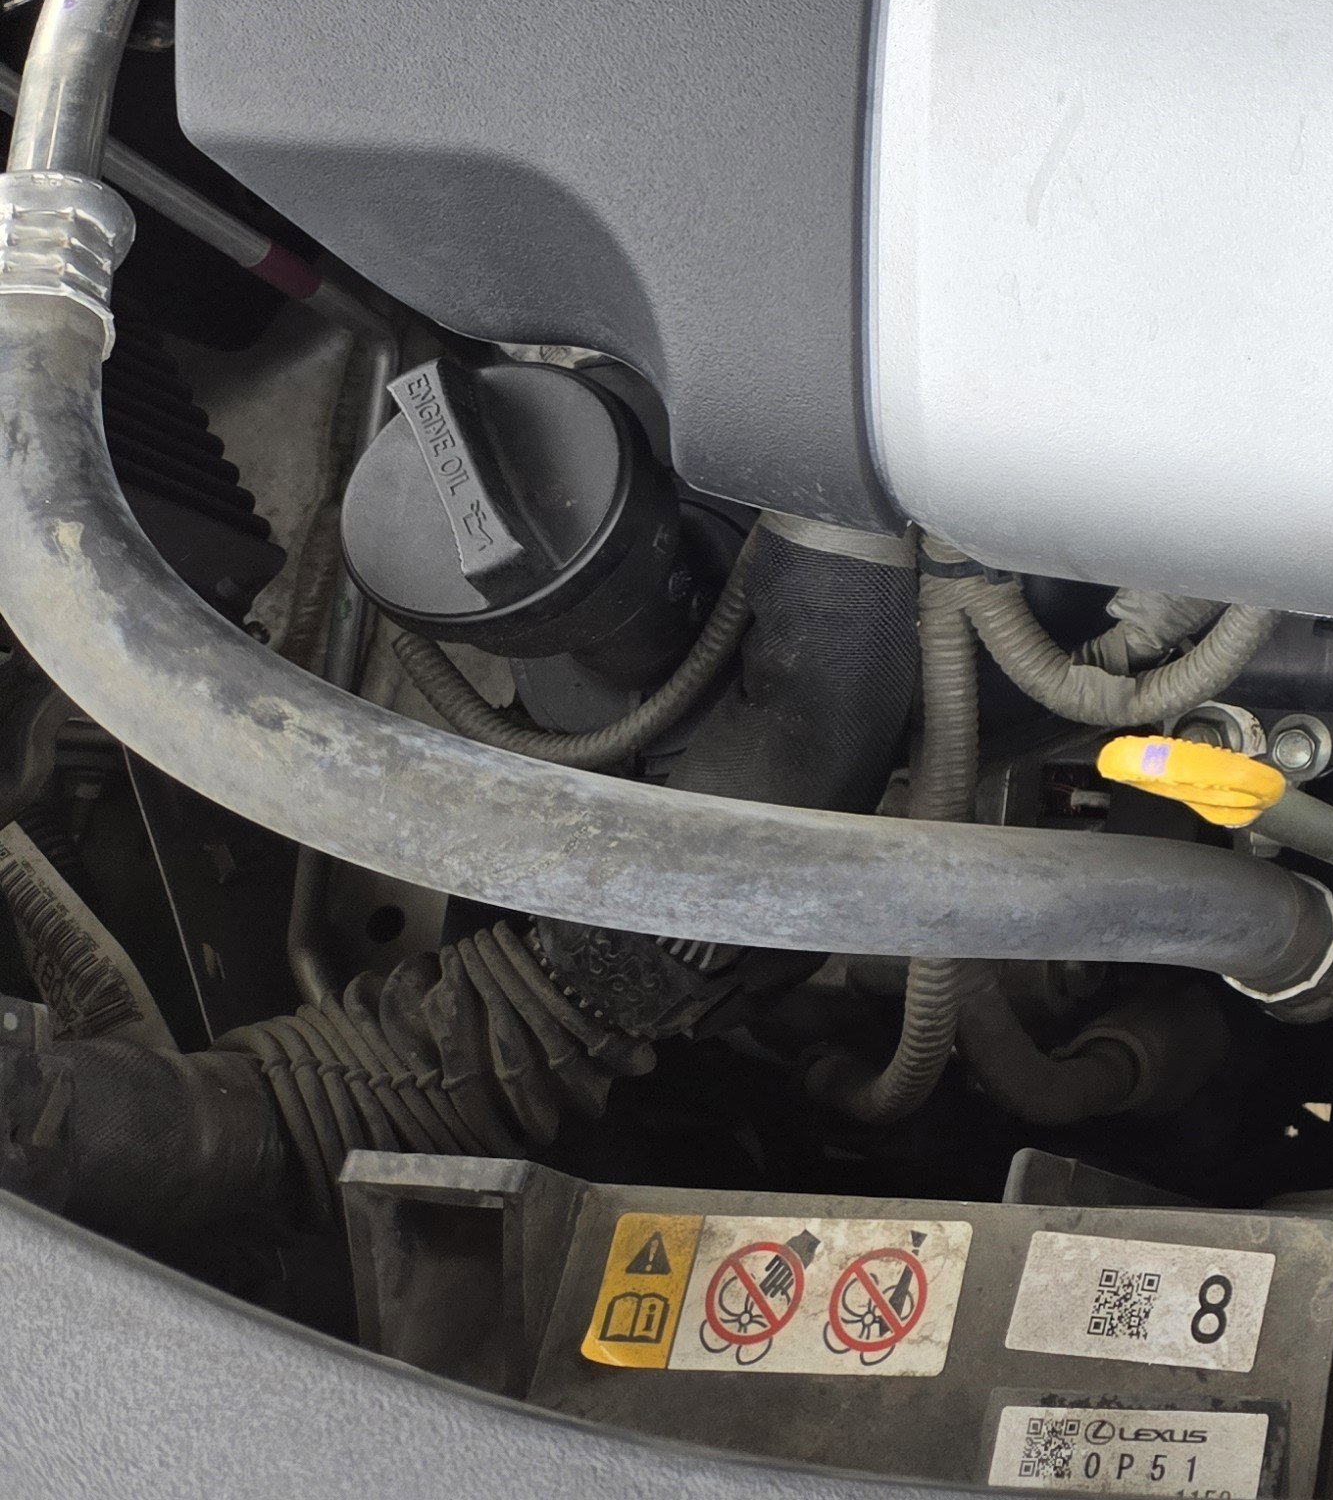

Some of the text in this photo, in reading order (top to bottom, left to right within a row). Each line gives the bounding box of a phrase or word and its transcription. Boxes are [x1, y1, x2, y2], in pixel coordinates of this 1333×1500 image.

[407, 373, 470, 496] ENGINE OIL
[1190, 1274, 1233, 1344] 8
[1118, 1428, 1208, 1444] LEXUS
